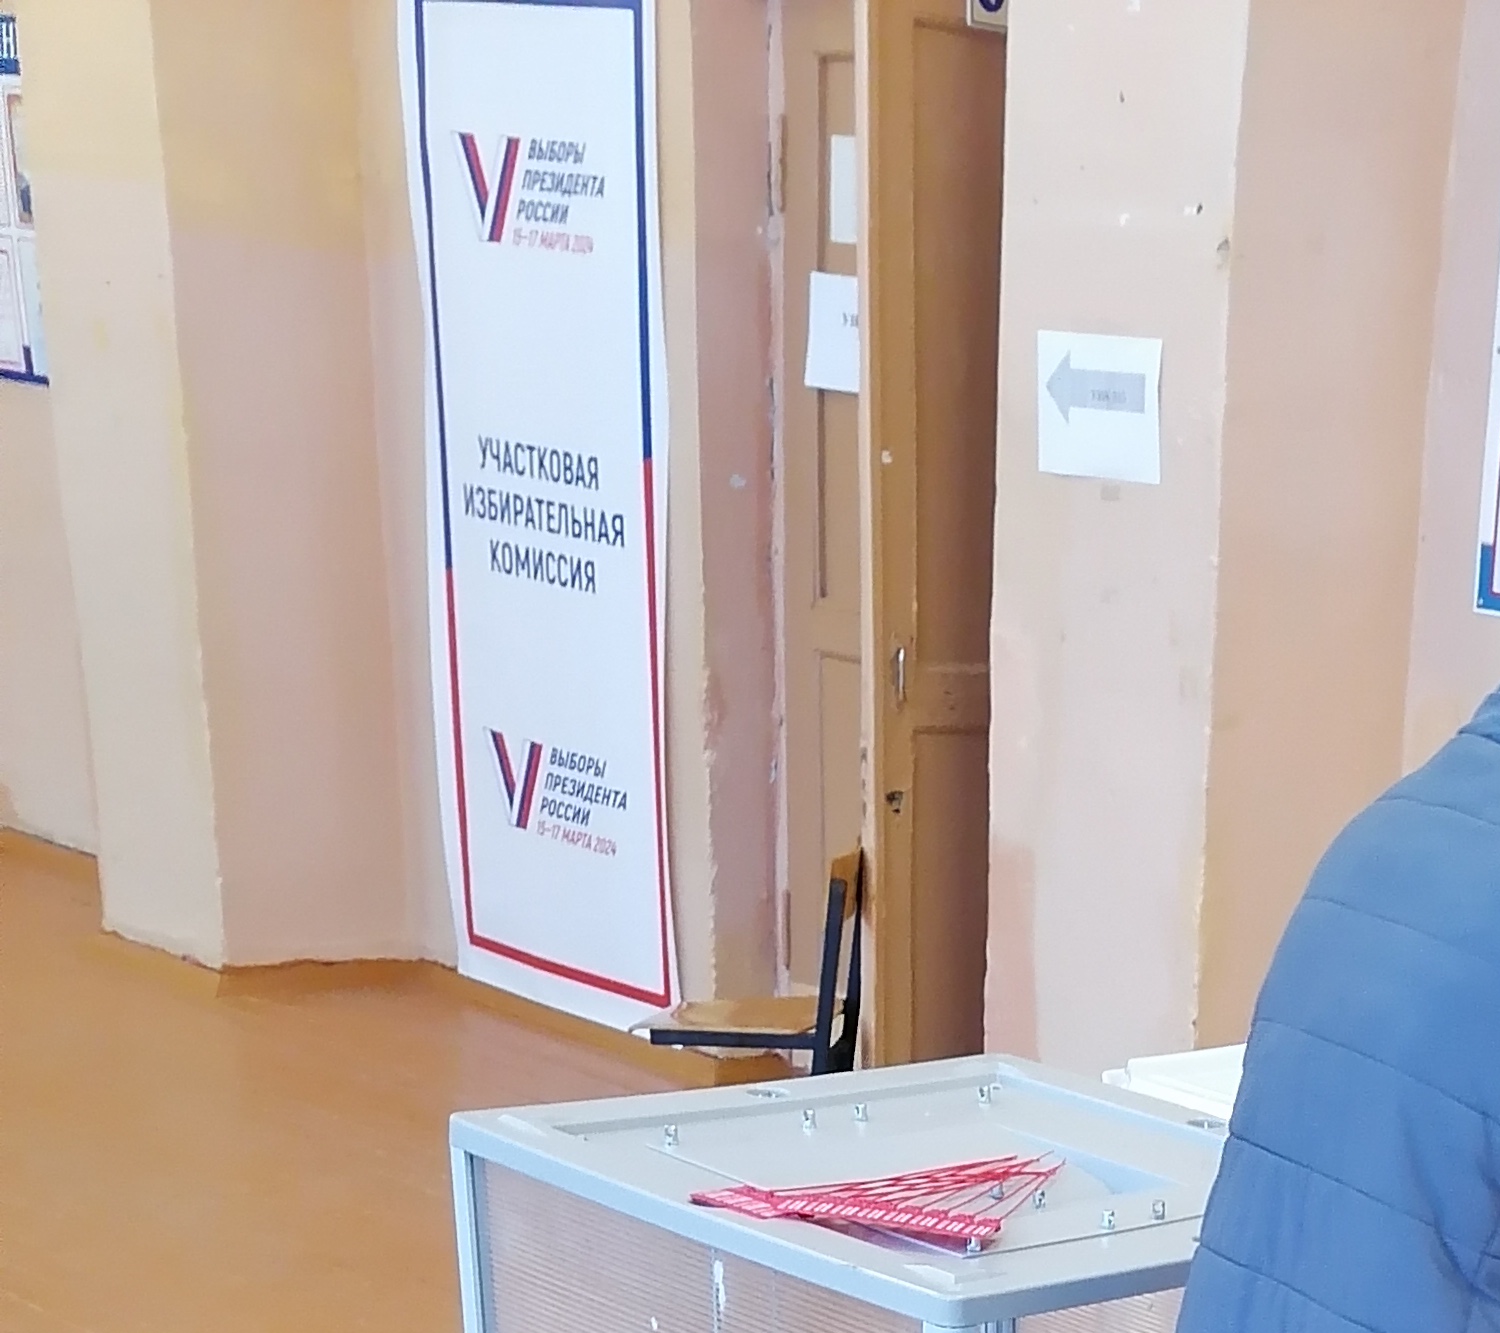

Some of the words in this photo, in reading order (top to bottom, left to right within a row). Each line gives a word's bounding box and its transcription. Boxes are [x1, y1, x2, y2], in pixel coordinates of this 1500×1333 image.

[527, 137, 586, 164] ВЫБОРЫ
[521, 169, 606, 198] ПРЕЗИДЕНТА
[515, 199, 569, 225] РОССИИ
[478, 434, 599, 491] УЧАСТКОВАЯ
[463, 482, 625, 548] ИЗБИРАТЕЛЬНАЯ
[490, 539, 597, 593] КОМИССИЯ
[549, 747, 607, 778] ВЫБОРЫ
[544, 772, 628, 810] ПРЕЗИДЕНТА
[540, 796, 591, 827] РОССИИ
